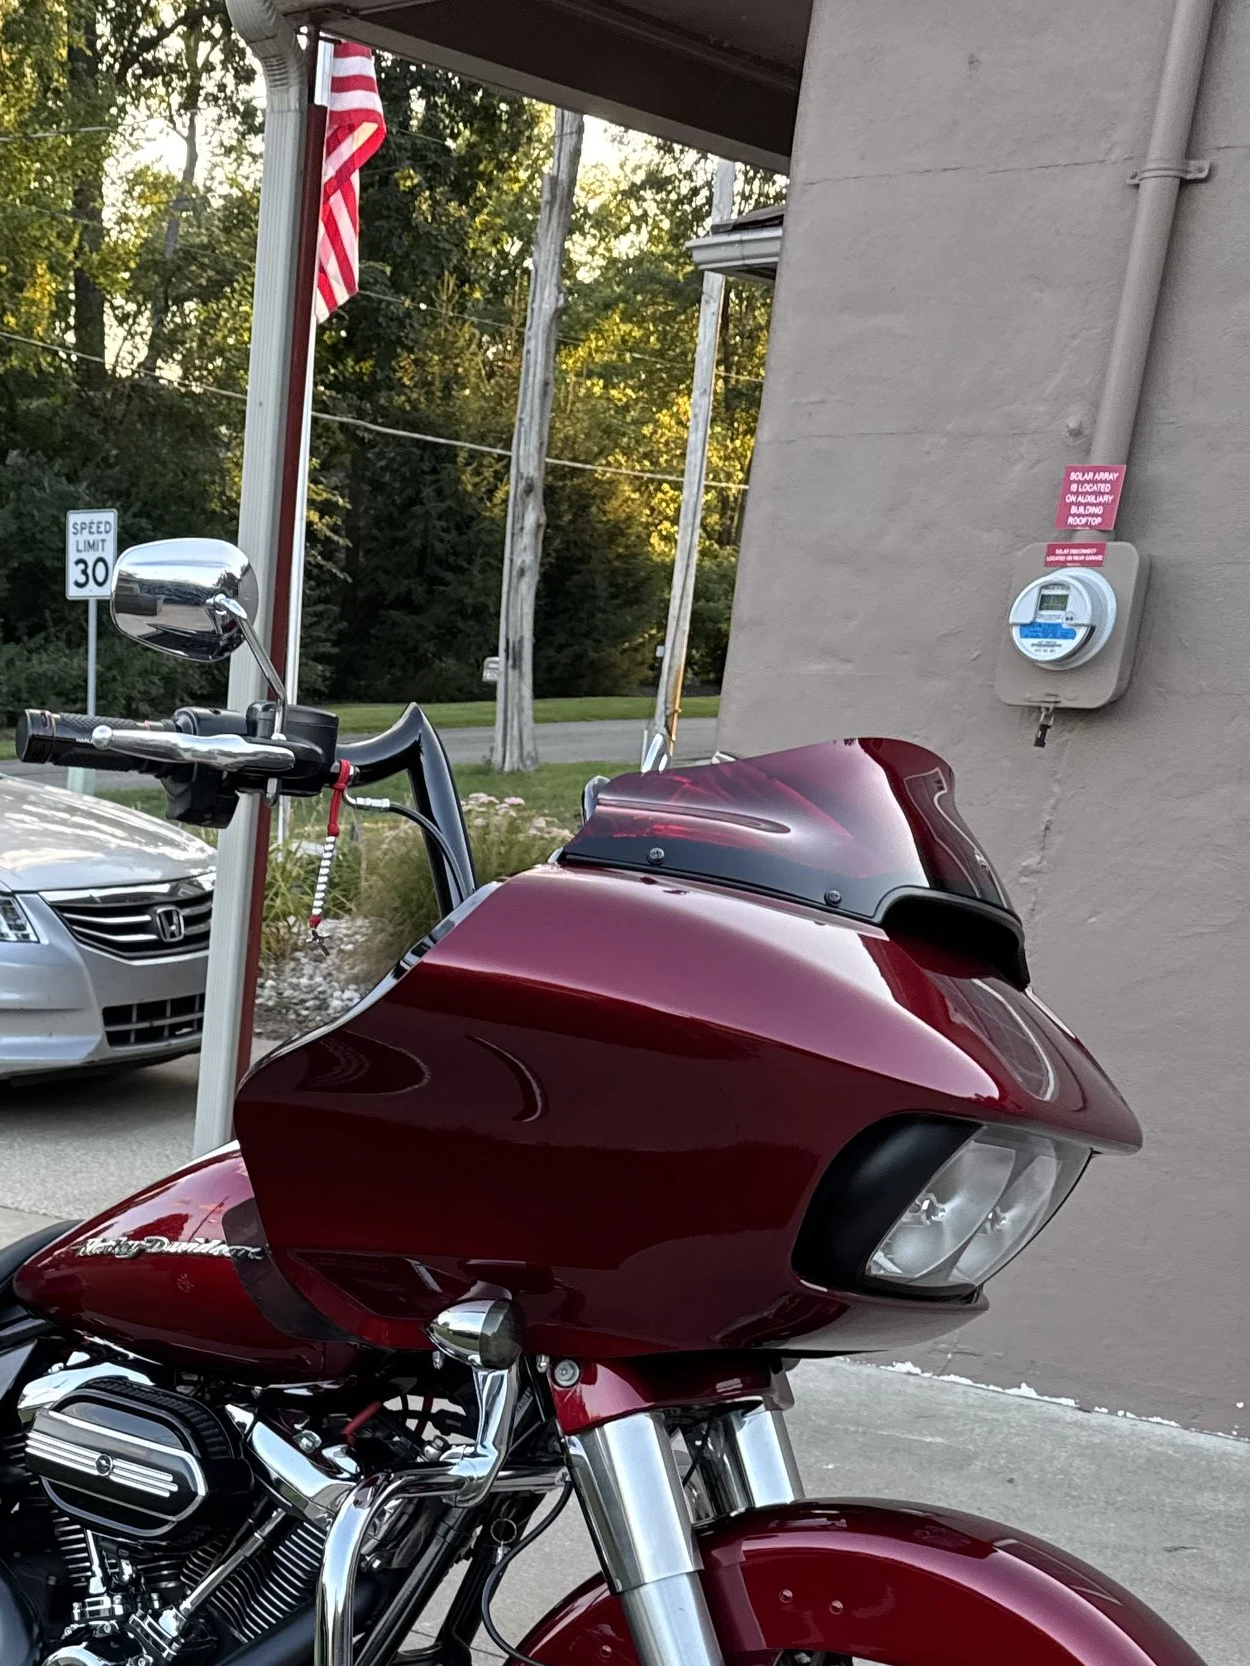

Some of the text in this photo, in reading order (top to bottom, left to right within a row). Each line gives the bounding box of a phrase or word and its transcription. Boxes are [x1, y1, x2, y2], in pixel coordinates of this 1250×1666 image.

[1070, 472, 1119, 481] SOLAR ARRAY
[1070, 483, 1111, 492] IS LOCATED
[1065, 495, 1114, 503] ON AUXILIARY
[1070, 506, 1103, 514] BUILDING
[1067, 517, 1102, 525] ROOFTOP
[72, 521, 111, 535] SPEED
[76, 539, 106, 553] LIMIT
[73, 556, 109, 589] 30
